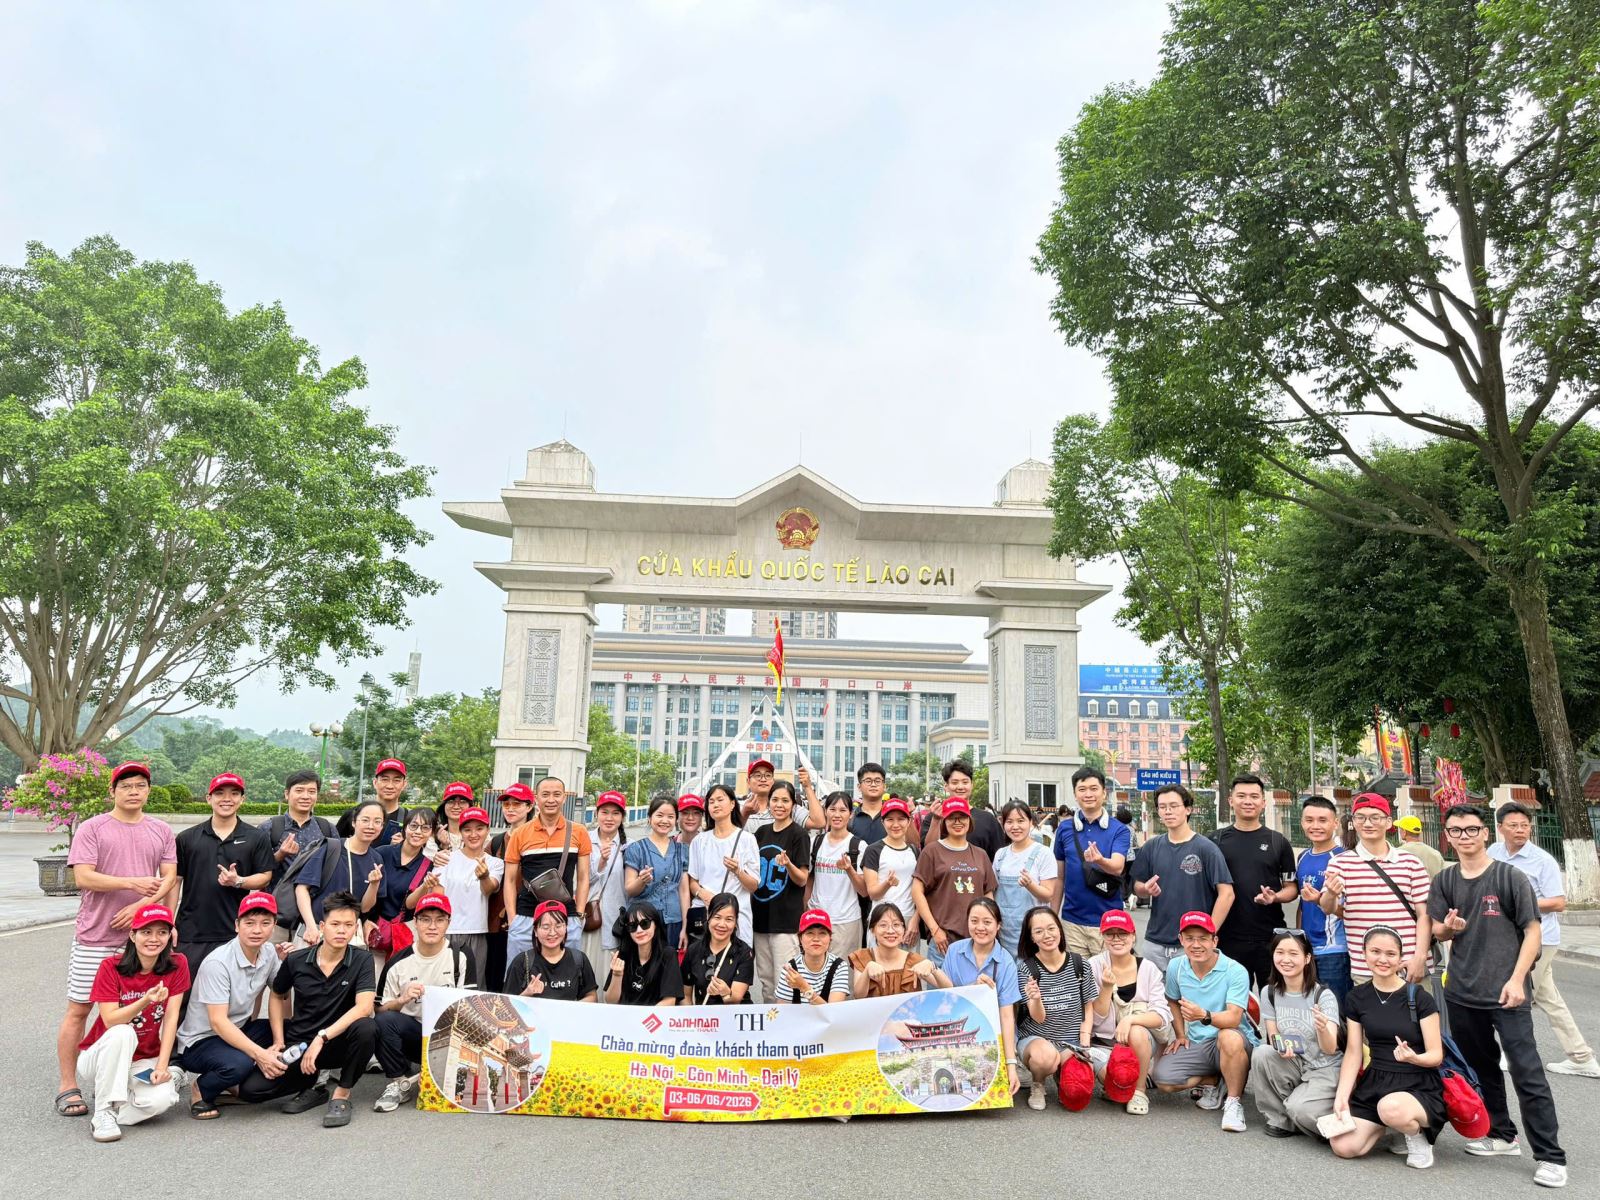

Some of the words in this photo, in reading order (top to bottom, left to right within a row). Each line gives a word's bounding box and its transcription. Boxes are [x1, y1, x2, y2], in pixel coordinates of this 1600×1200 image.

[637, 550, 683, 576] CỬA
[692, 550, 752, 579] KHẨU
[760, 556, 825, 581] QUỐC
[833, 556, 860, 583] TẾ
[865, 560, 910, 585] LÀO
[917, 565, 955, 586] CAI
[623, 672, 912, 690] 中华人民共和国河口口岸
[746, 743, 782, 751] 中国河口
[669, 1018, 719, 1028] DANHNAM
[734, 1013, 765, 1031] TH
[601, 1035, 633, 1051] Chào
[638, 1039, 675, 1057] mừng
[679, 1040, 711, 1056] đoàn
[715, 1041, 752, 1057] khách
[757, 1041, 789, 1057] tham
[793, 1043, 824, 1060] quan
[630, 1062, 647, 1077] Hà
[652, 1065, 673, 1080] Nội
[688, 1067, 713, 1082] Côn
[717, 1069, 748, 1084] Minh
[762, 1069, 783, 1085] Đại
[787, 1067, 798, 1087] lý
[669, 1091, 751, 1108] 03-06/06/2026
